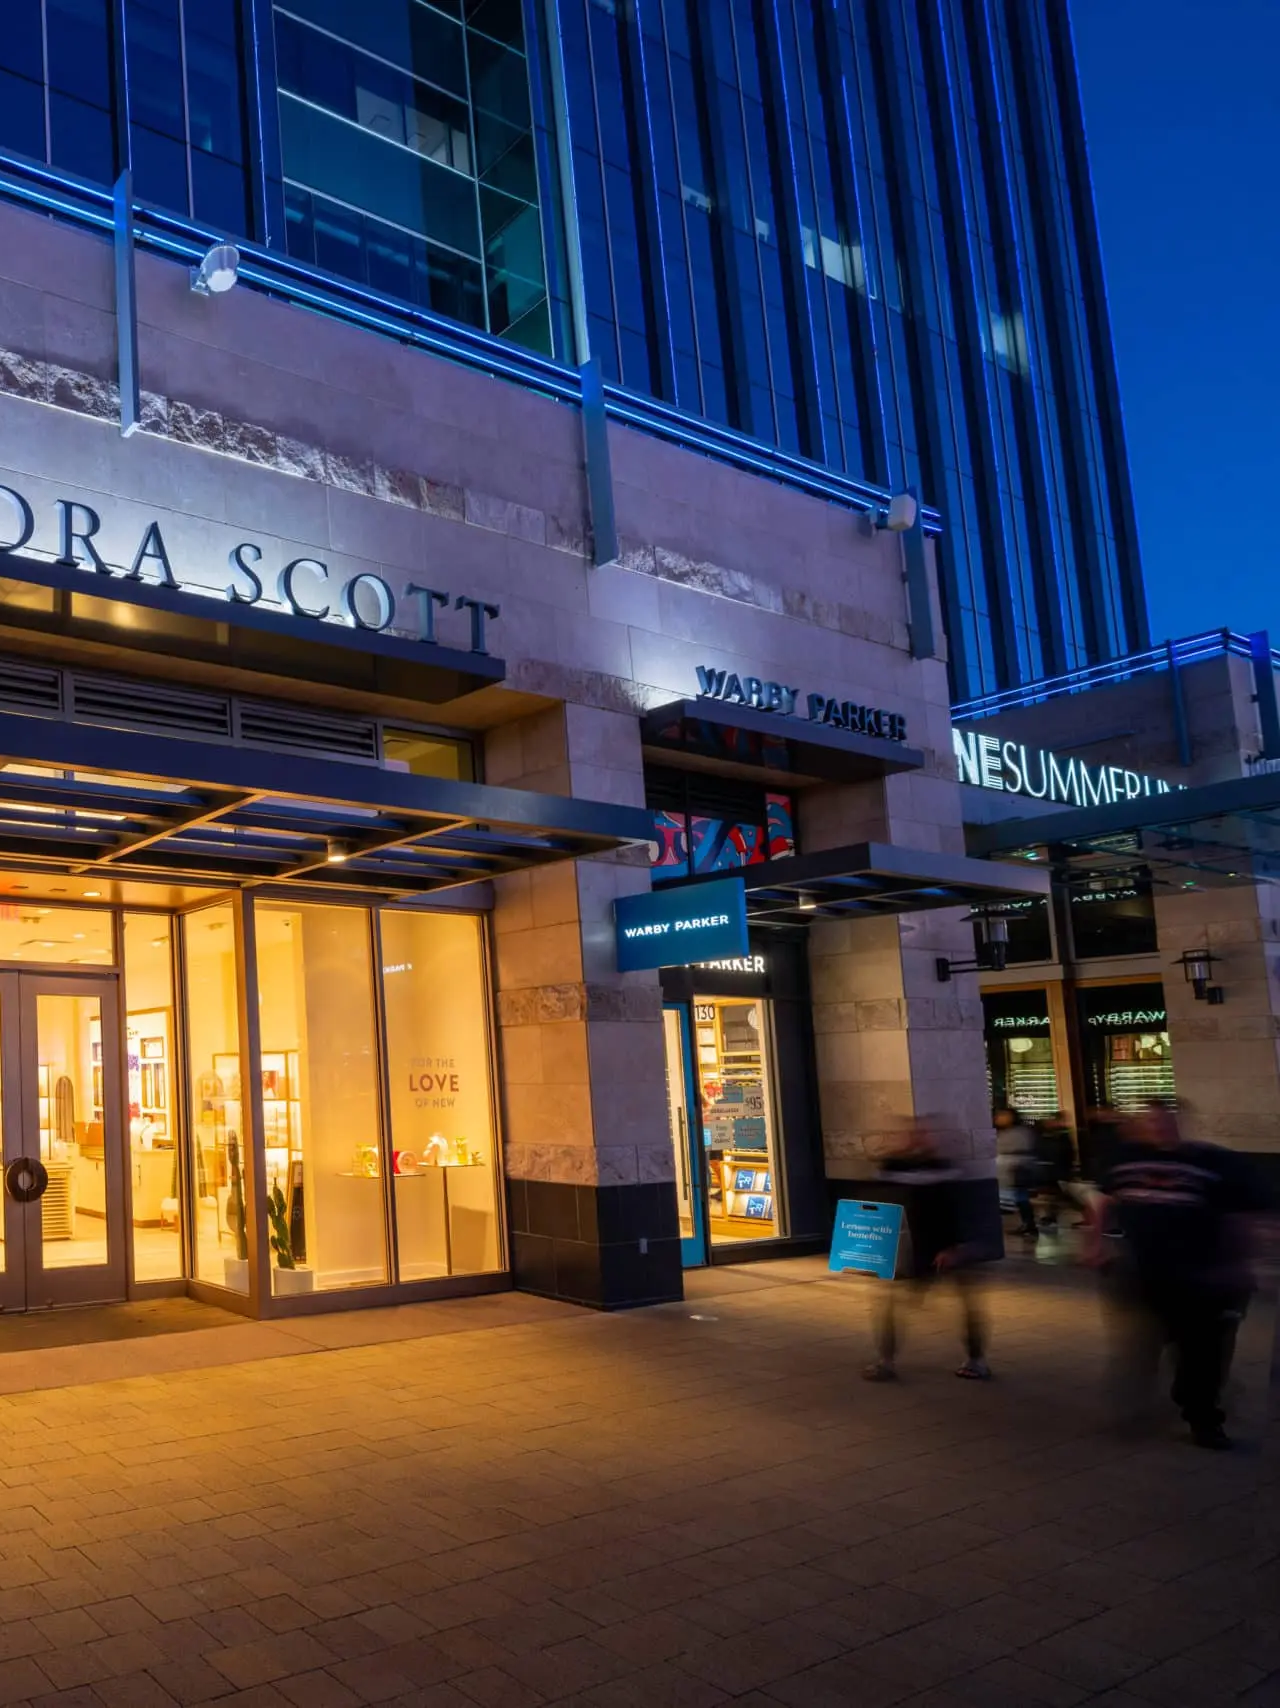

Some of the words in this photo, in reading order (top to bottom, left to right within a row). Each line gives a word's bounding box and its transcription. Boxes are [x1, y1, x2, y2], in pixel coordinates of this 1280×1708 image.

[225, 542, 501, 655] SCOTT
[695, 665, 800, 715] WARBY
[807, 693, 908, 741] PARKER
[624, 922, 670, 939] WARBY
[675, 914, 729, 932] PARKER
[700, 955, 766, 974] ARKER
[695, 1003, 716, 1021] 130
[410, 1056, 433, 1069] FOR
[436, 1057, 455, 1069] THE
[409, 1073, 460, 1093] LOVE
[415, 1096, 429, 1109] OF
[432, 1096, 456, 1109] NEW
